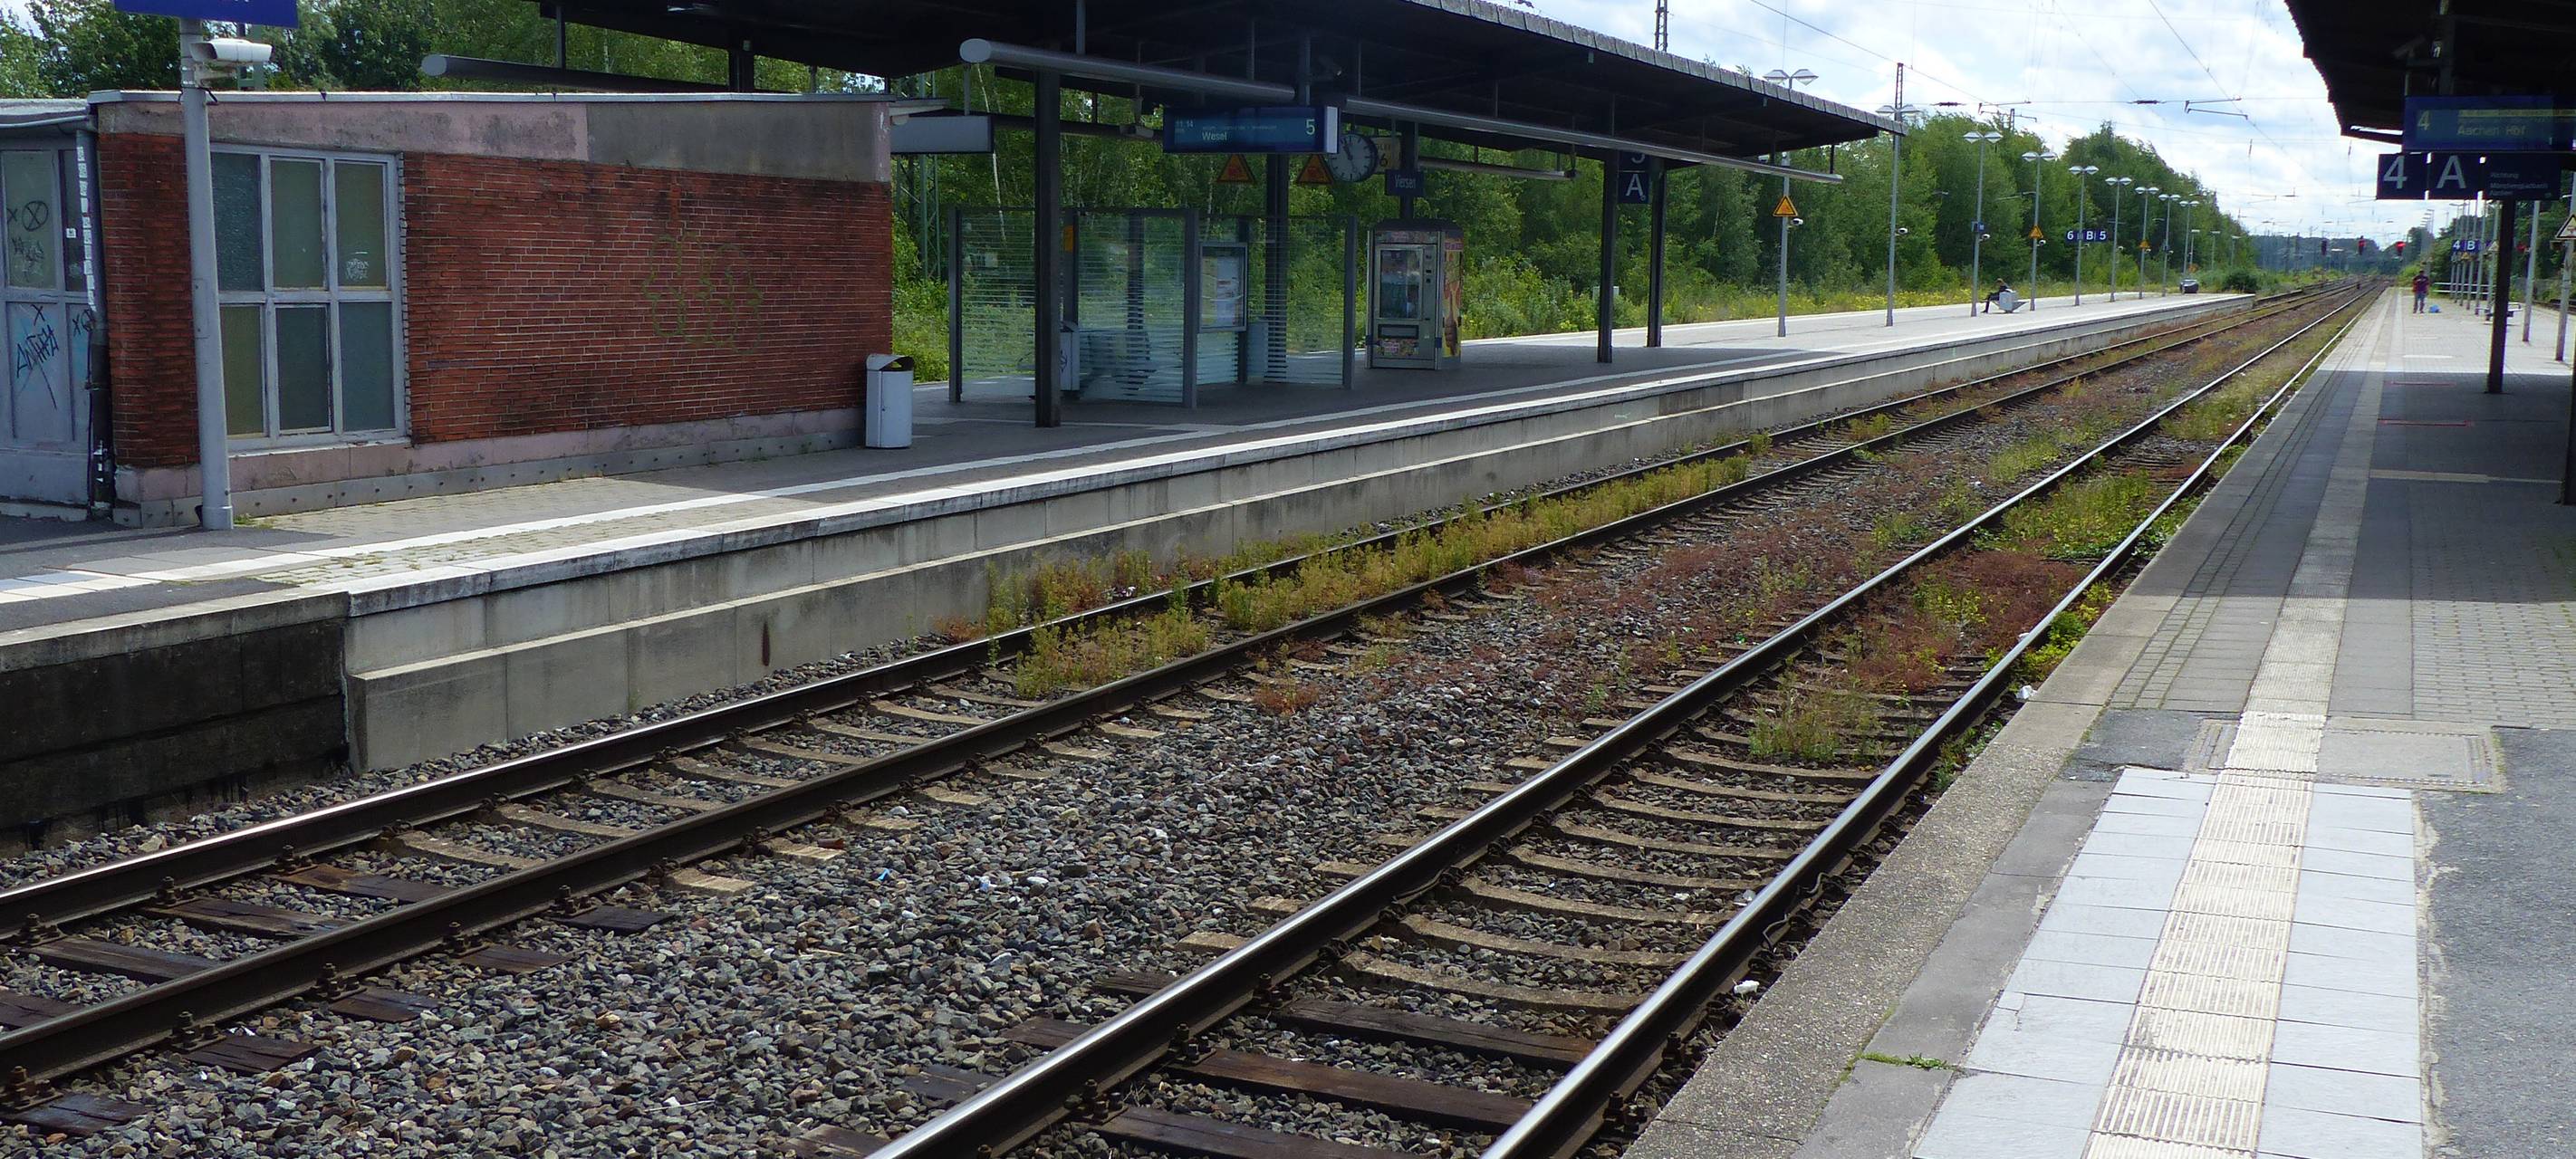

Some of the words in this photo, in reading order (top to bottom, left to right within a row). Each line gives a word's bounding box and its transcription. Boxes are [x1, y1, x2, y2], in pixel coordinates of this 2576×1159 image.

[1305, 119, 1316, 135] 5
[2417, 111, 2431, 130] 4
[1201, 130, 1228, 141] Wesel
[2383, 155, 2408, 189] 4
[2437, 155, 2467, 189] A
[1625, 173, 1644, 196] A
[2067, 231, 2074, 240] 6
[2086, 231, 2093, 240] B
[2100, 231, 2106, 240] 5
[2453, 240, 2461, 250] 4
[2466, 240, 2475, 250] B
